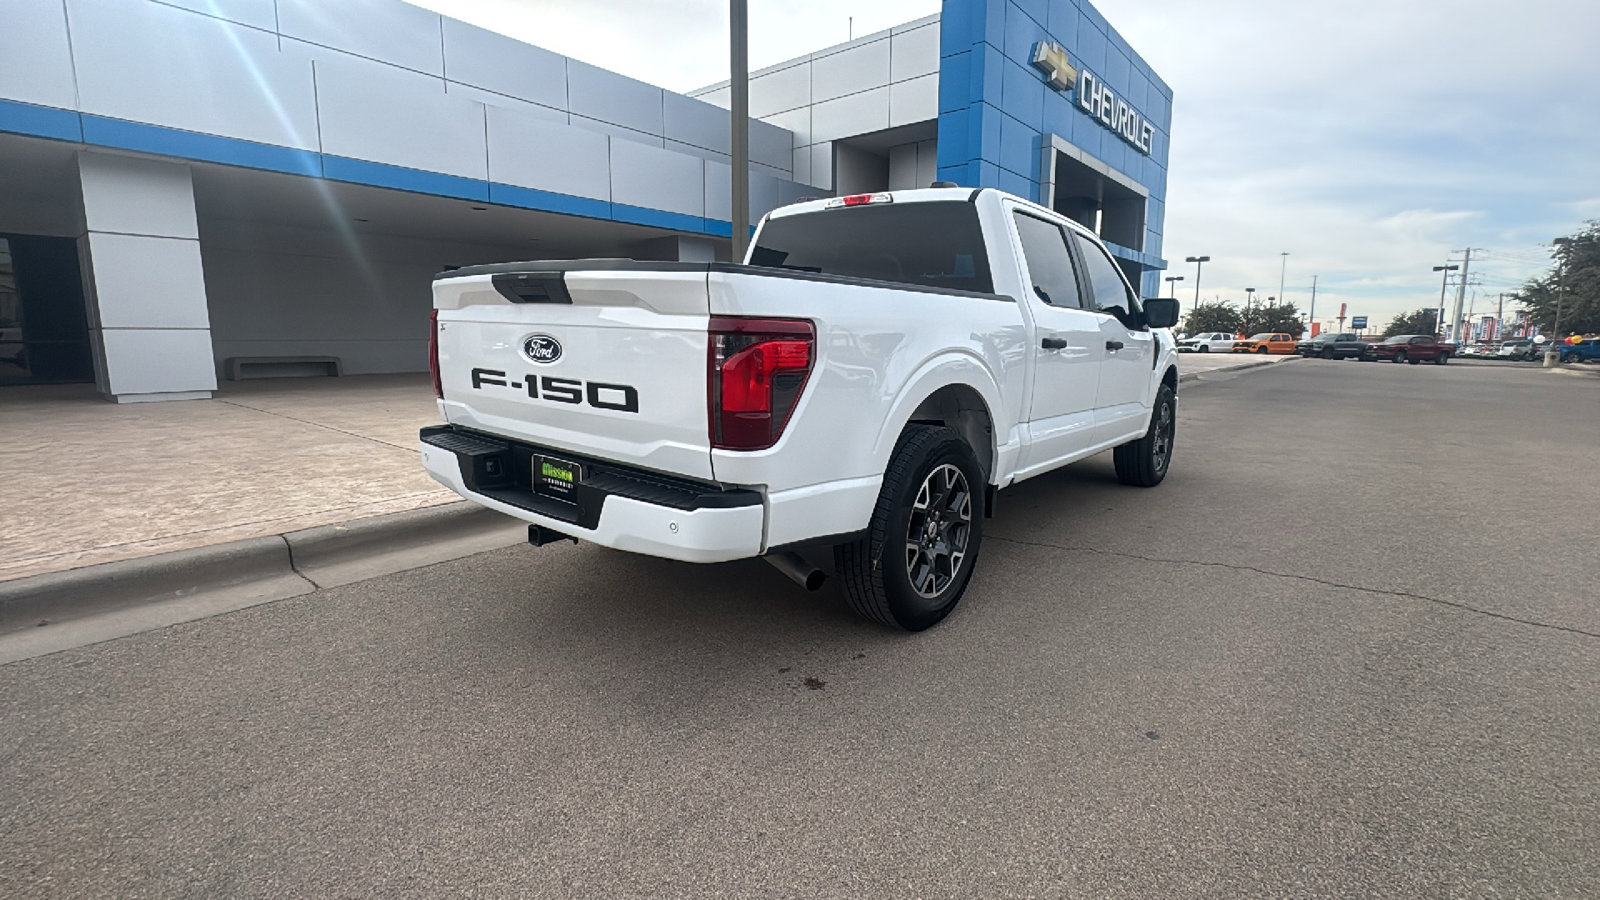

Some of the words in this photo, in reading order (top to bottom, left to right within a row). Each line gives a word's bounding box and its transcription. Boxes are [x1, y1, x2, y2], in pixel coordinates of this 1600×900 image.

[1081, 69, 1155, 154] CHEVROLET
[529, 338, 554, 359] Ford
[471, 368, 639, 413] F-150
